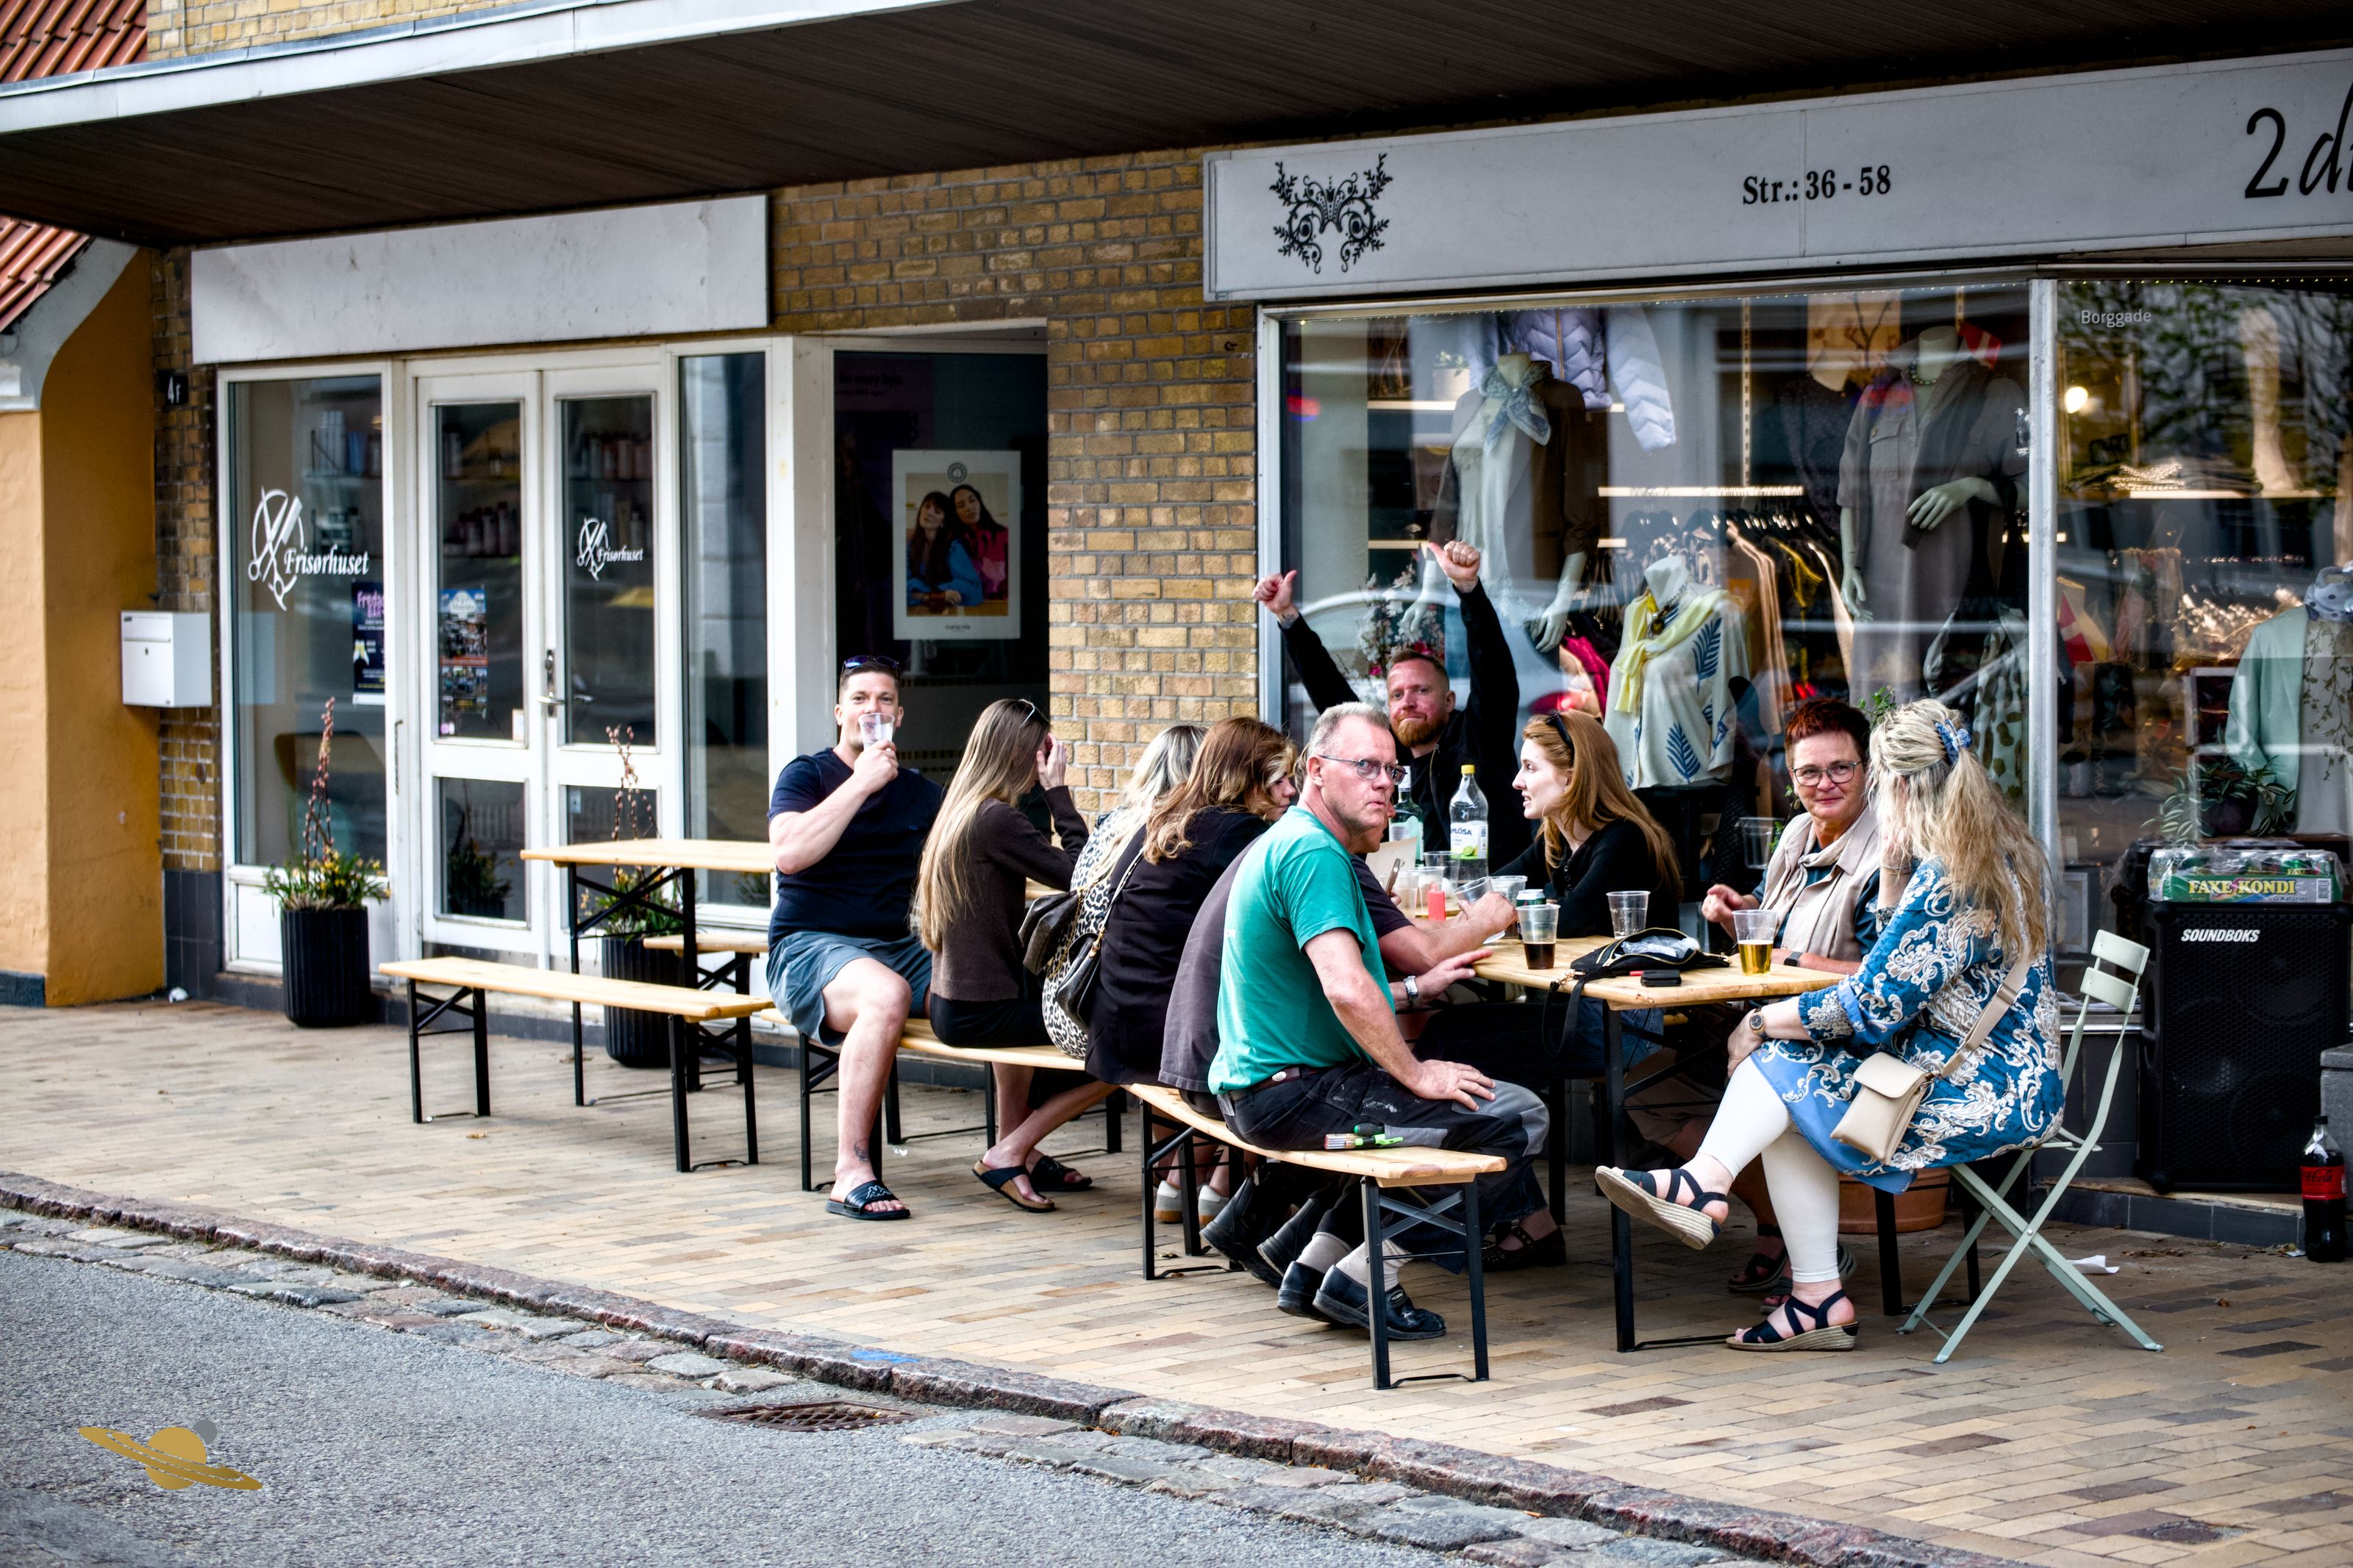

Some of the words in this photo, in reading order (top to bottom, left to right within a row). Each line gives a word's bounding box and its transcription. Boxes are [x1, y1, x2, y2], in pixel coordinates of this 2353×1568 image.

[2244, 82, 2353, 198] 2d
[1743, 176, 1799, 205] Str.:
[1805, 169, 1836, 200] 36
[1859, 165, 1891, 196] 58
[2081, 308, 2152, 328] Borggade
[2188, 880, 2233, 895] FAXE
[2237, 880, 2296, 895] KONDI
[2180, 928, 2261, 943] SOUNDBOKS
